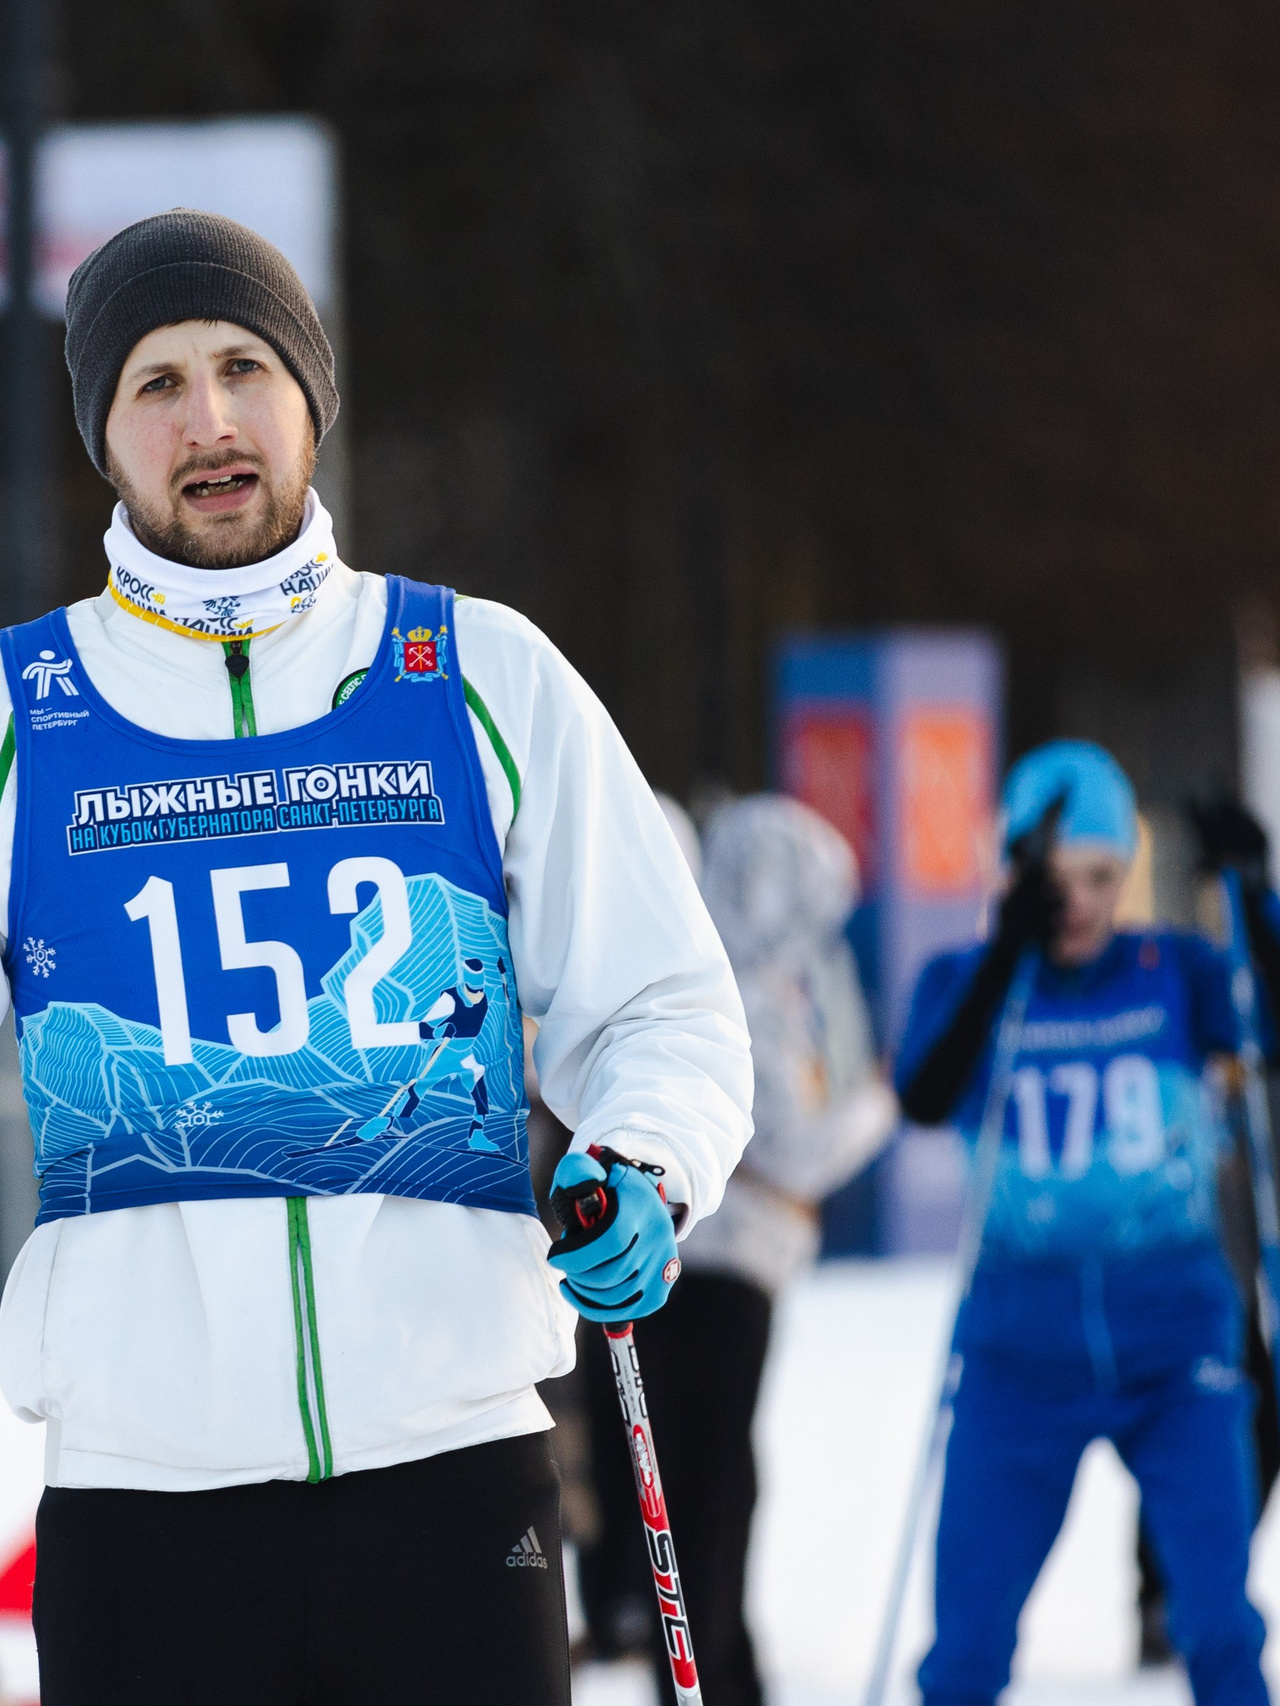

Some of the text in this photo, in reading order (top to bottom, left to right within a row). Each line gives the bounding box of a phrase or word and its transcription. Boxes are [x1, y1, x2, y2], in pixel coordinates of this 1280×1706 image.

[116, 566, 155, 602] КРОСС
[340, 677, 363, 700] CELTIC
[30, 709, 90, 723] СПОРТИВНЫЙ
[32, 719, 78, 731] ПЕТЕРБУРГ
[77, 765, 430, 825] ЛЫЖНЫЕ ГОНКИ
[72, 798, 440, 850] НА КУБОК ГУБЕРНАТОРА САНКТ-ПЕТЕРБУРГА
[123, 856, 420, 1066] 152
[505, 1552, 548, 1569] adidas
[644, 1526, 694, 1663] STC
